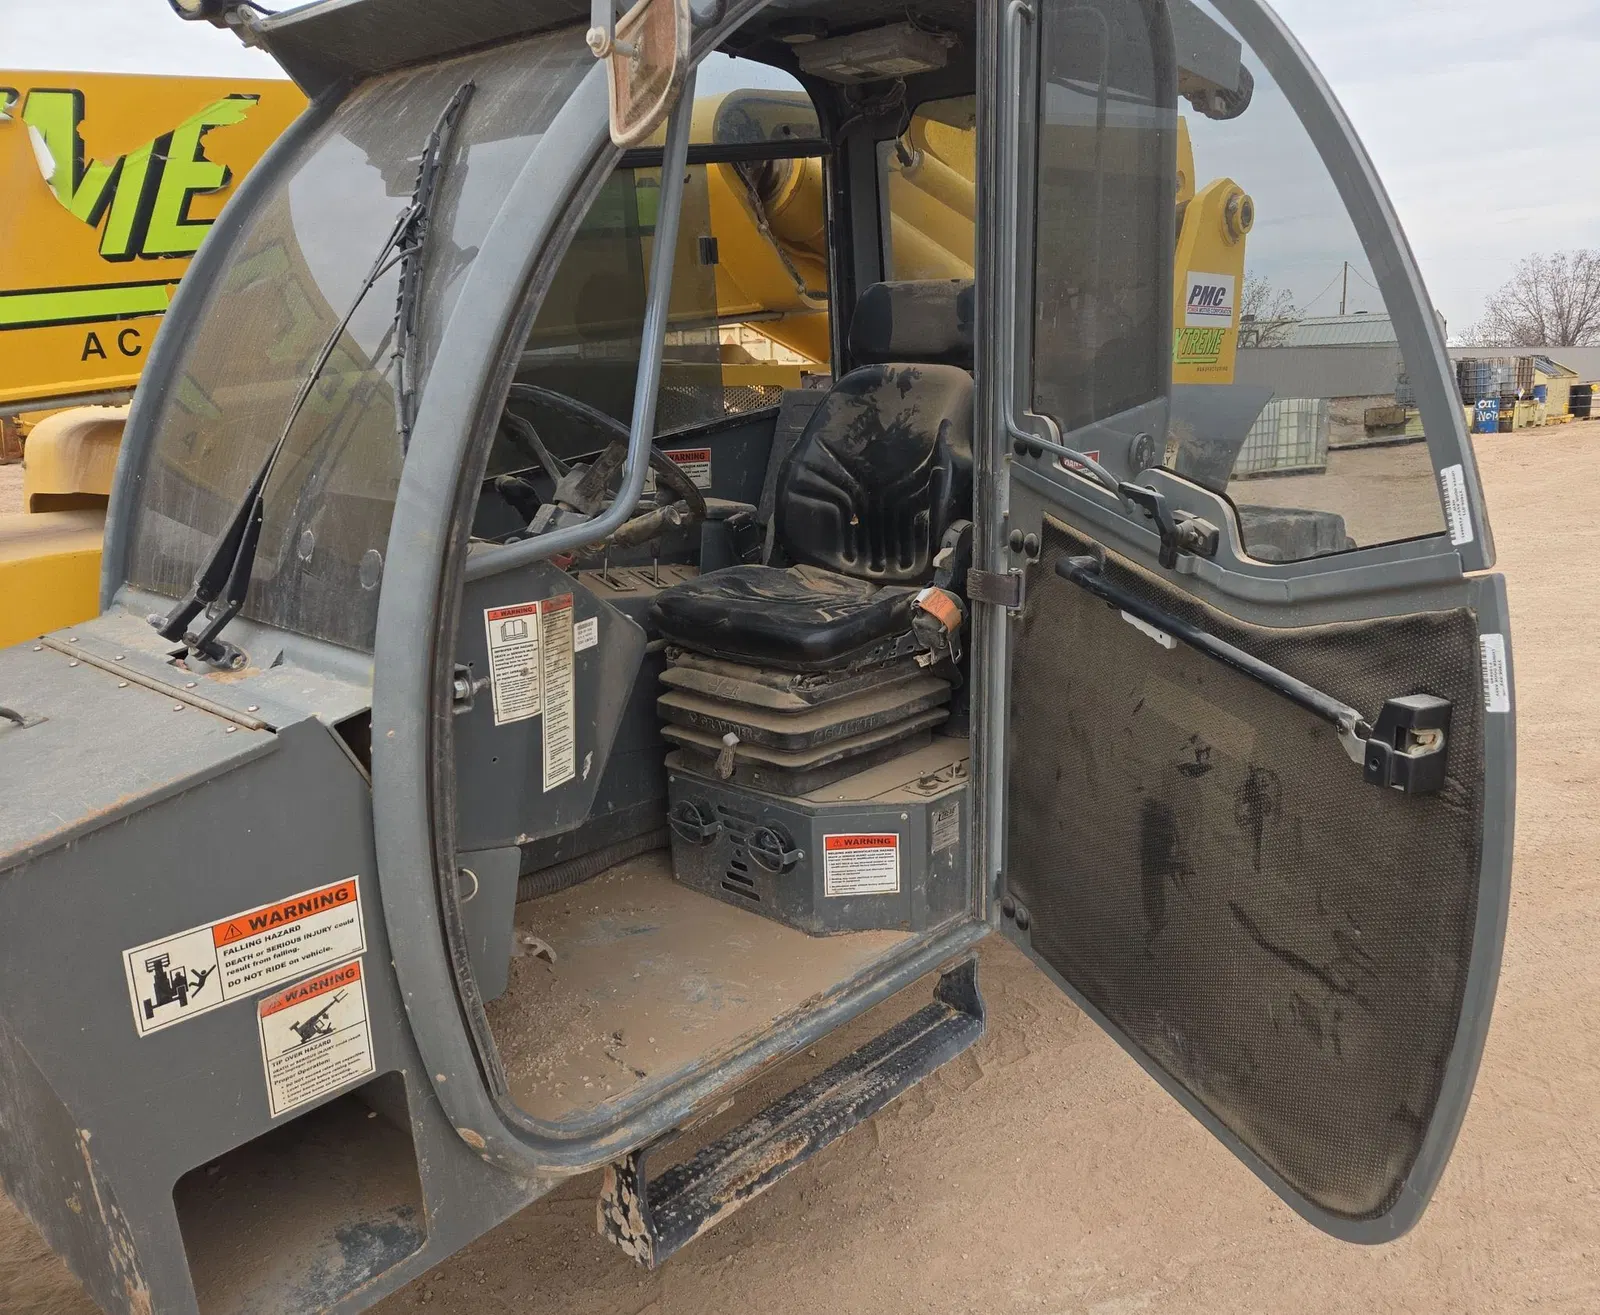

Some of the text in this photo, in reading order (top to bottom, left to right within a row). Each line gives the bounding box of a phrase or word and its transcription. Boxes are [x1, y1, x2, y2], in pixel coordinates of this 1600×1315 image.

[0, 87, 260, 263] ME
[1188, 284, 1226, 306] PMC
[1173, 328, 1225, 364] XTREME
[1478, 400, 1496, 408] OIL
[501, 606, 532, 616] WARNING
[248, 888, 349, 930] WARNING
[223, 925, 300, 956] FALLING HAZARD
[225, 954, 253, 968] DEATH
[266, 938, 301, 953] SERIOUS
[304, 926, 332, 940] INJURY
[334, 918, 354, 929] could
[226, 948, 300, 976] result from falling.
[228, 979, 241, 988] DO
[244, 971, 262, 982] NOT
[266, 962, 286, 974] RIDE
[302, 946, 333, 960] vehicle.
[285, 969, 355, 1002] WARNING
[285, 1051, 303, 1062] OVER
[305, 1039, 331, 1053] HAZARD
[296, 1053, 315, 1063] SERIOUS
[274, 1058, 330, 1085] Proper Operation:
